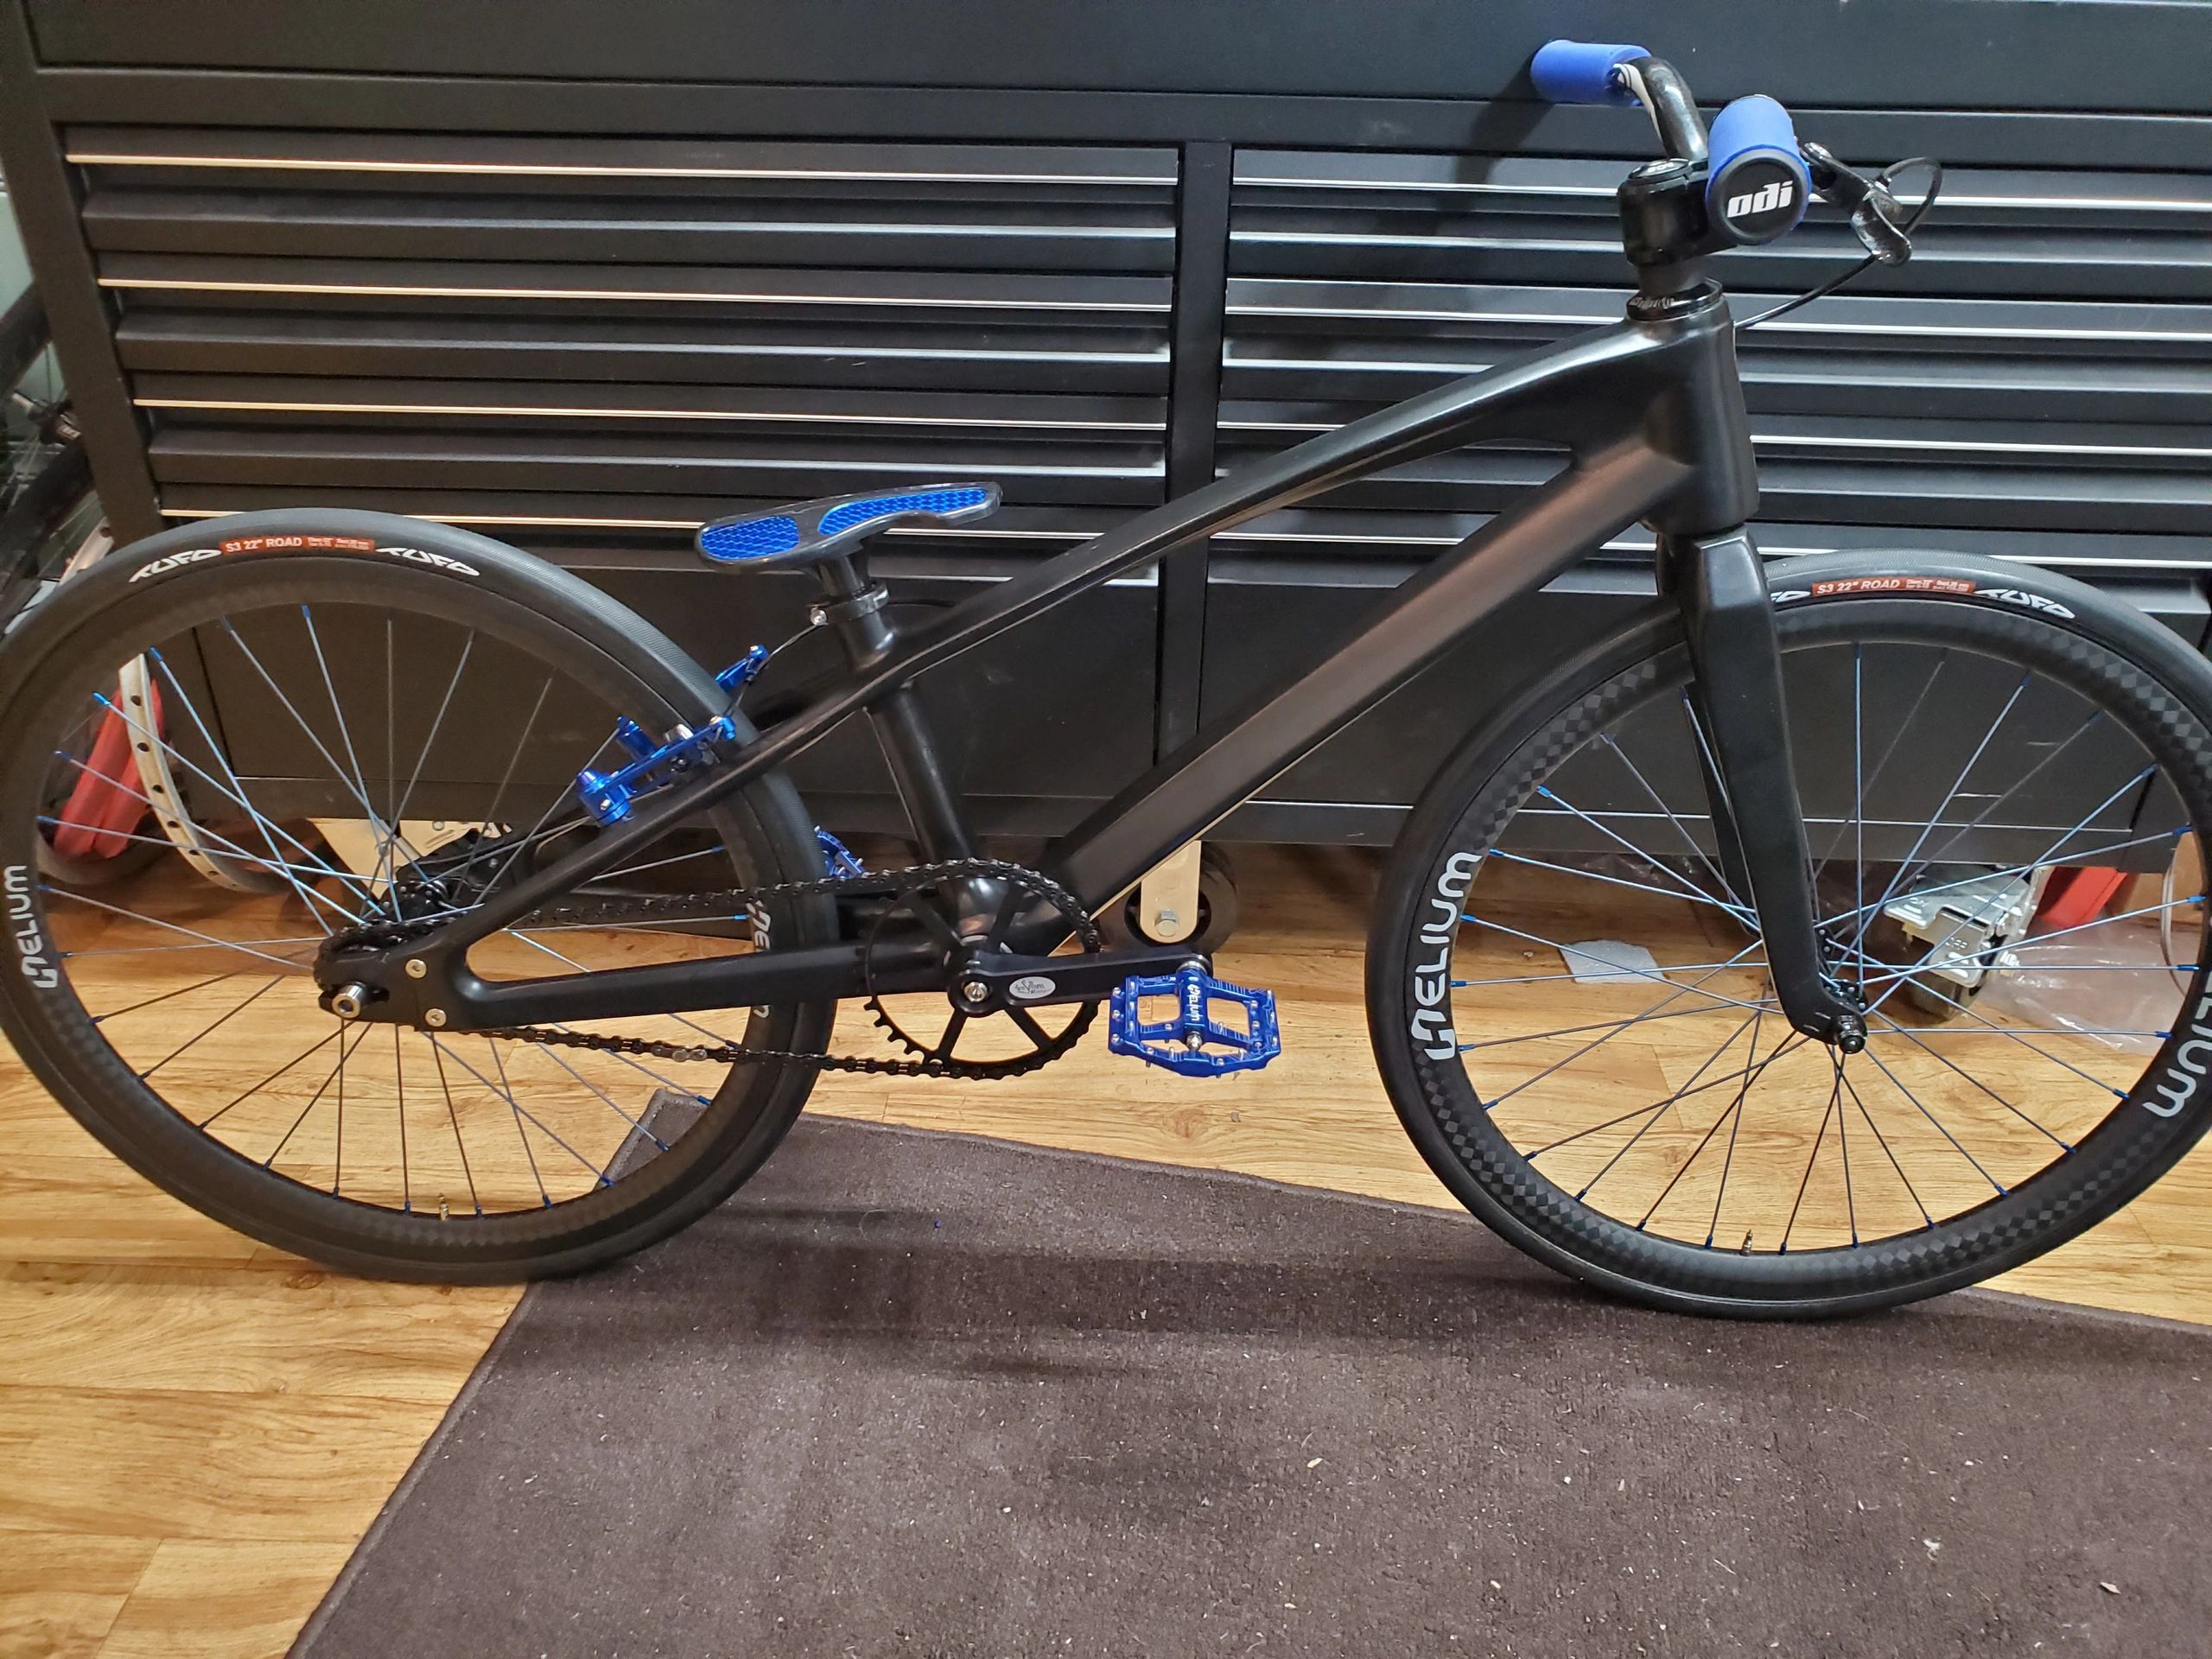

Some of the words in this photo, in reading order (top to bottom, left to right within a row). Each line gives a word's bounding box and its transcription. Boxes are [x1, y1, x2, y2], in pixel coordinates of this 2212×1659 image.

[226, 543, 241, 553] S3
[265, 537, 302, 548] ROAD
[129, 549, 222, 583] TUFO
[374, 547, 480, 577] TUFO
[1817, 583, 1834, 594] S3
[1860, 579, 1901, 590] ROAD
[1974, 588, 2075, 620] TUFO
[1410, 851, 1484, 1061] HELIUM
